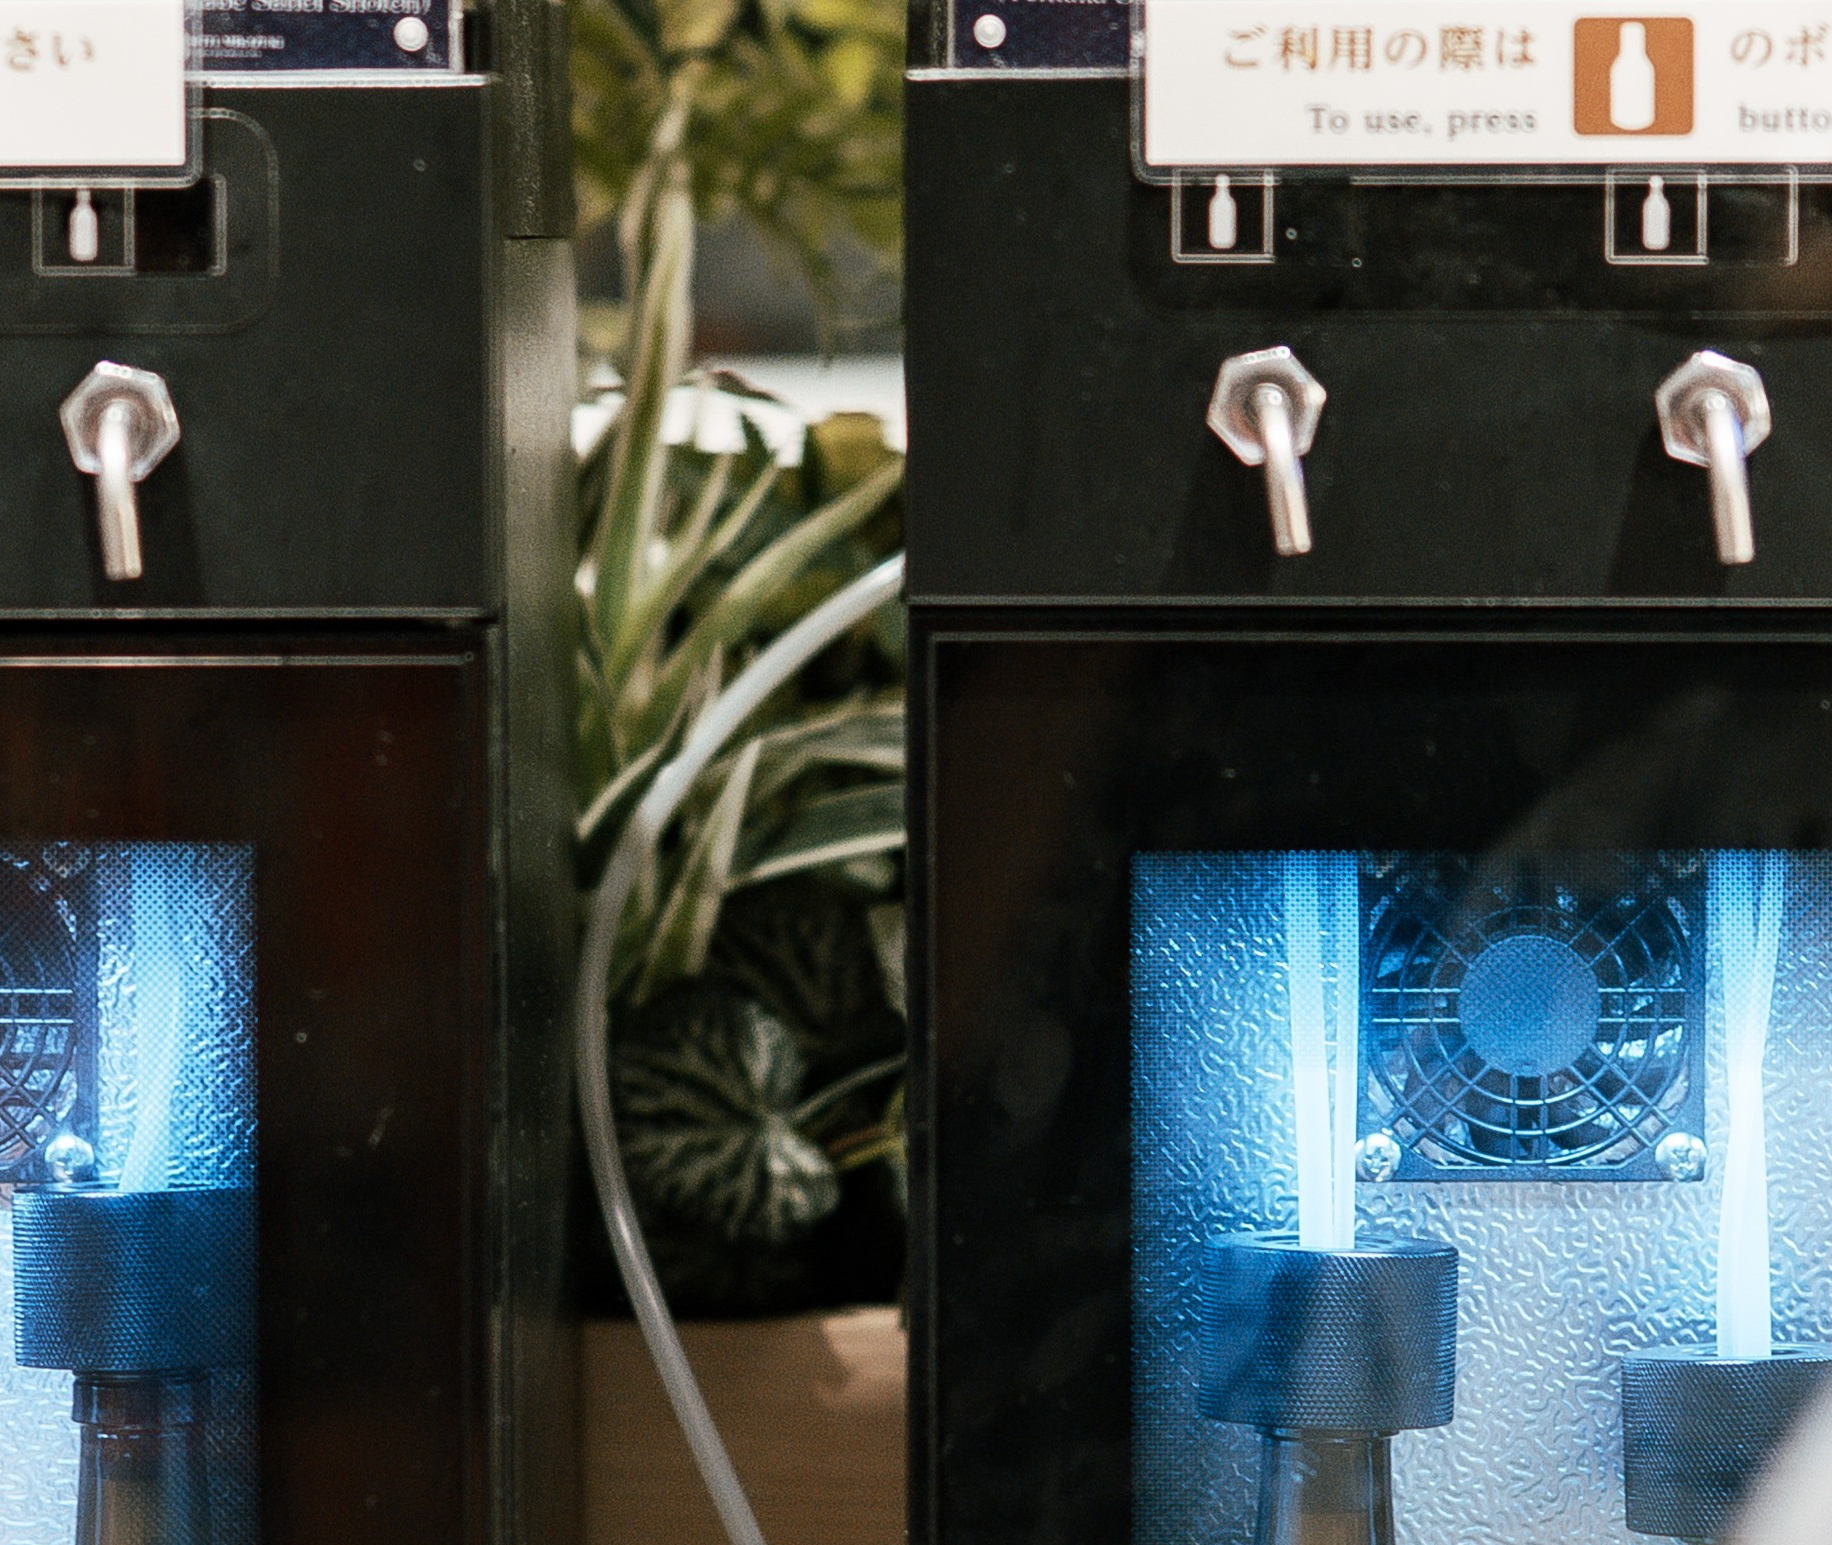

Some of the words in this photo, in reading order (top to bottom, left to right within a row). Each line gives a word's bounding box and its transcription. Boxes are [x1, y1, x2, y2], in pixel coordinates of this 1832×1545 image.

[1224, 23, 1536, 71] ご利用の際は
[1307, 105, 1350, 132] To
[1447, 111, 1538, 140] press
